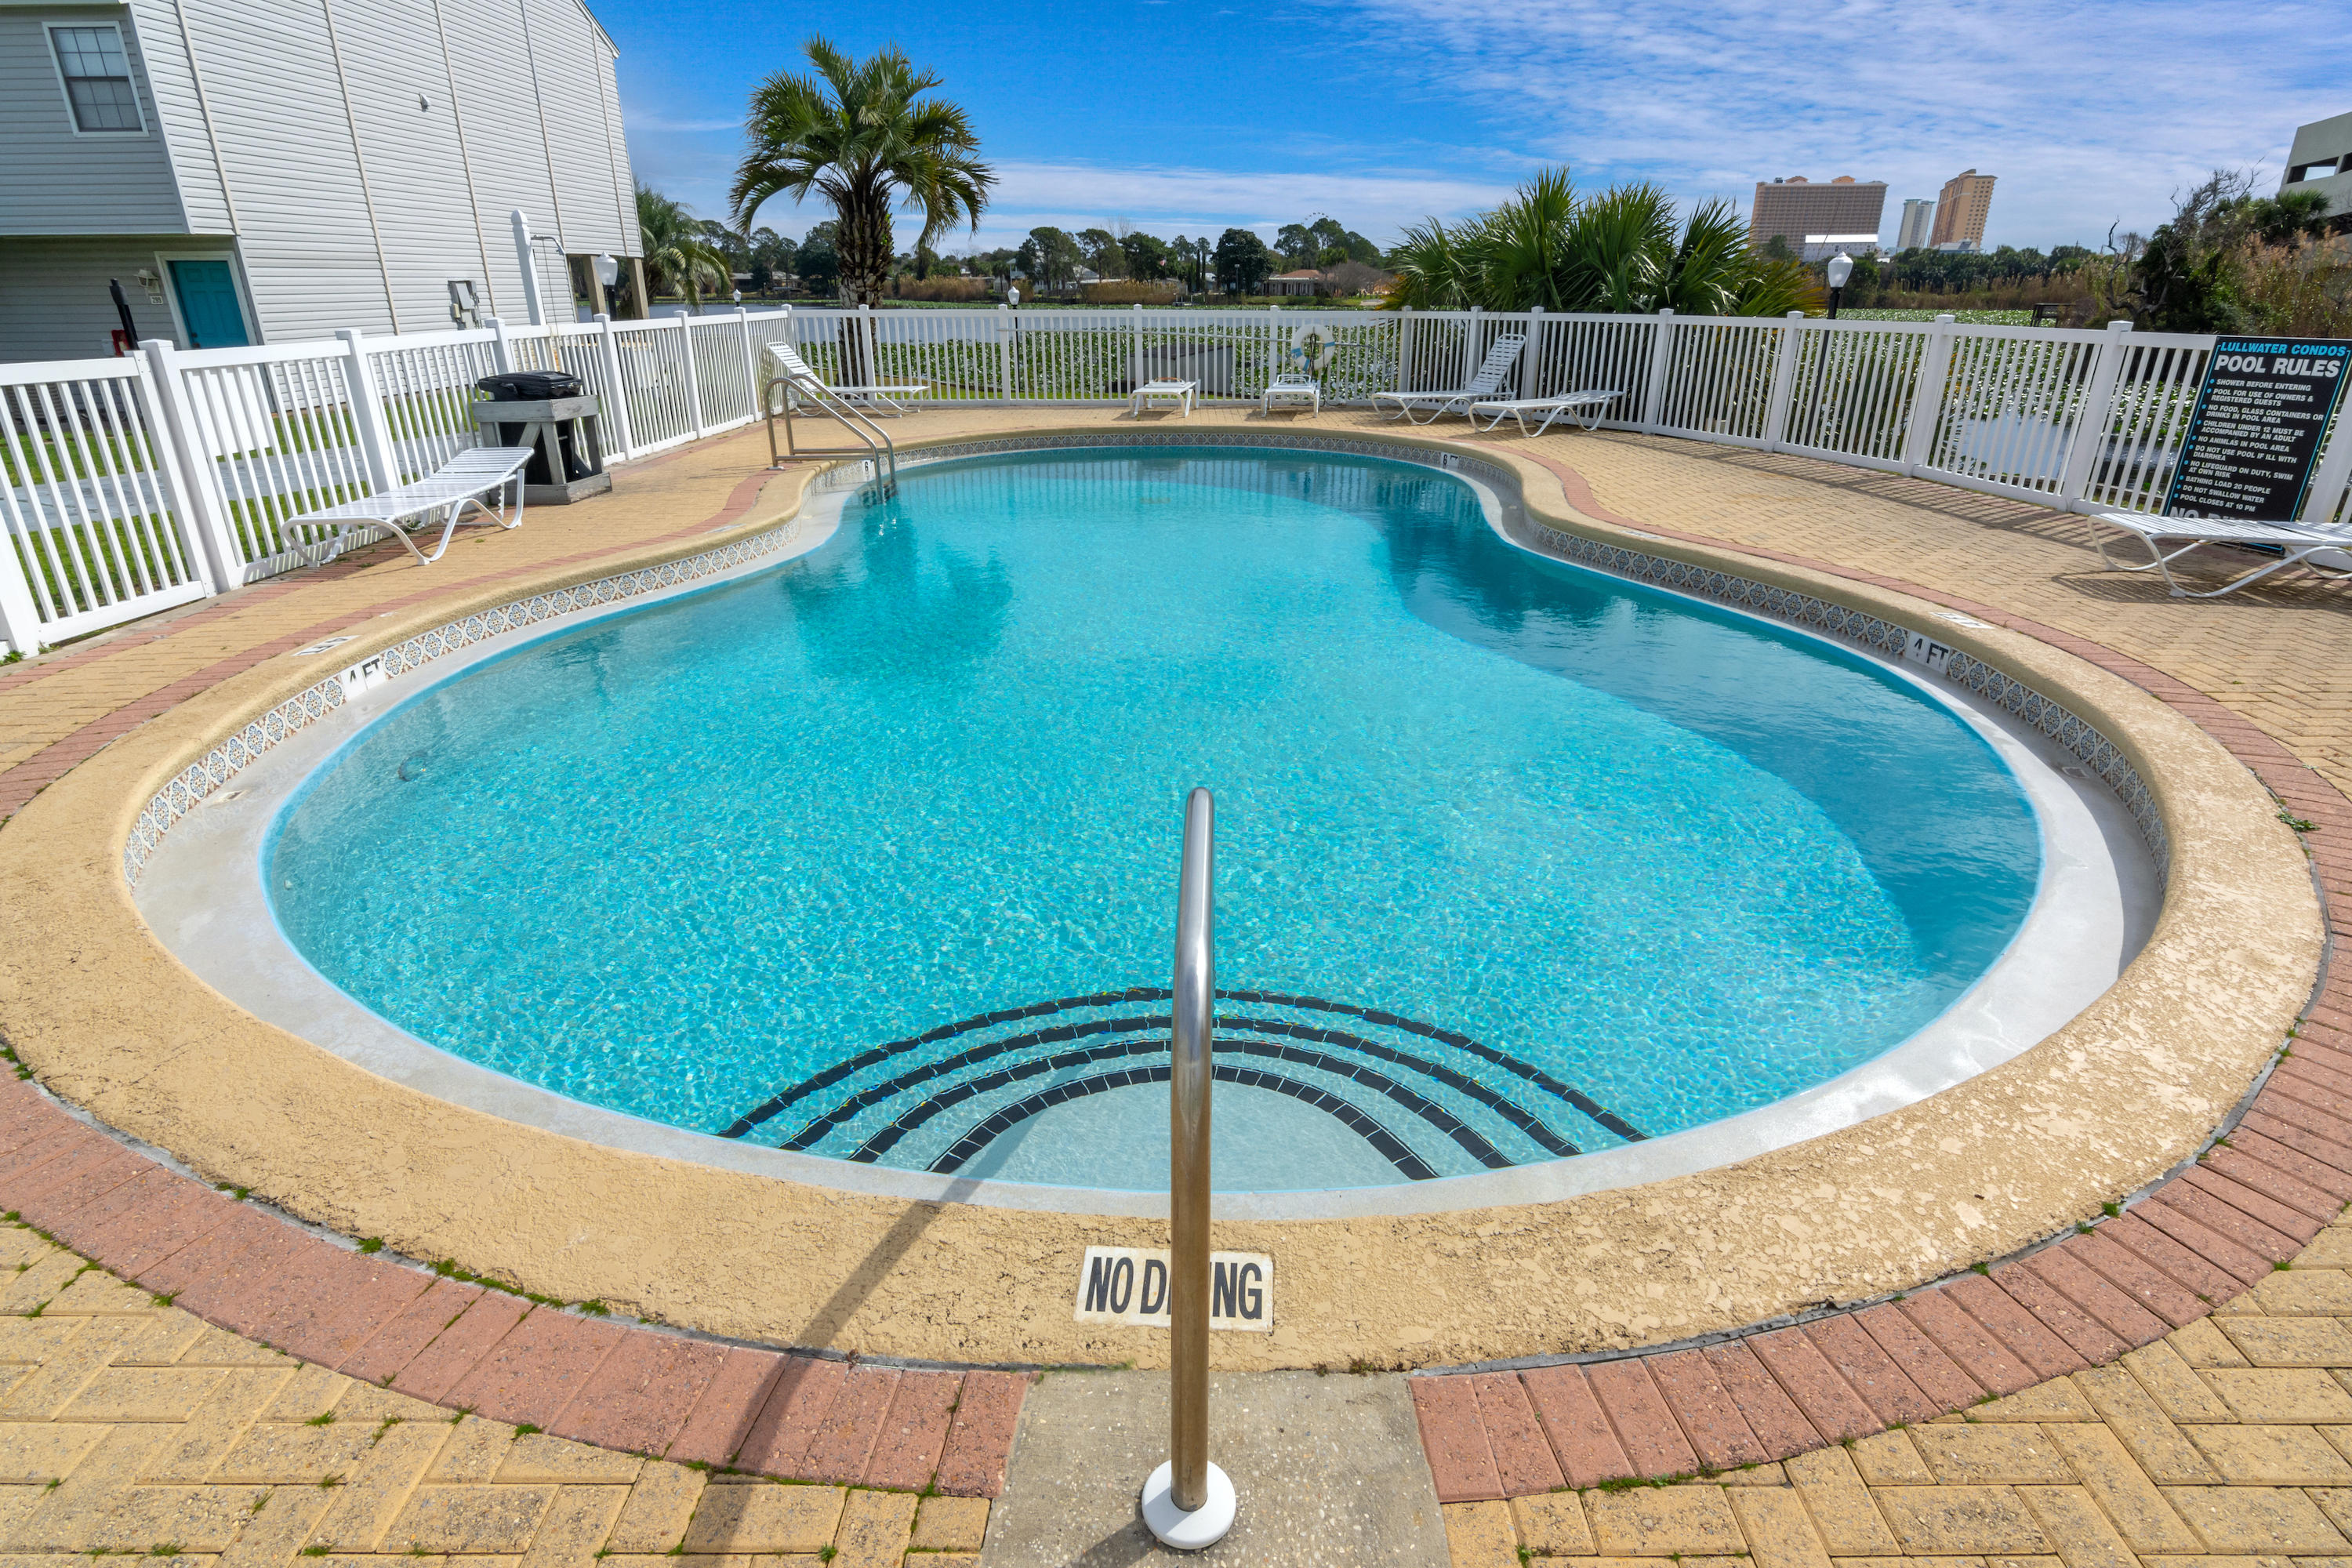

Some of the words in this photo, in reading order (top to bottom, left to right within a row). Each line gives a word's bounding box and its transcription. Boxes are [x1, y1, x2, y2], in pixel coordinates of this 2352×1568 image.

[2220, 342, 2287, 354] LULLWATER
[2292, 345, 2346, 356] CONDOS
[2215, 355, 2266, 372] POOL
[2272, 358, 2341, 377] RULES
[2274, 383, 2311, 391] ENTERING
[2212, 395, 2252, 404] REGISTERED
[2266, 410, 2310, 419] CONTAINERS
[2204, 420, 2236, 429] CHILDREN
[2201, 427, 2249, 437] ACCOMPANIED
[2193, 452, 2226, 460] DIARRHEA
[2201, 463, 2237, 472] LIFEGUARD
[2251, 470, 2271, 478] DUTY,
[2186, 476, 2213, 485] BATHING
[2244, 485, 2270, 494] PEOPLE
[2199, 497, 2224, 506] CLOSES
[2209, 489, 2241, 499] SWALLOW
[2242, 495, 2264, 503] WATER
[1926, 643, 1949, 663] FT
[1085, 1257, 1134, 1314] NO
[1140, 1259, 1262, 1319] DNG
